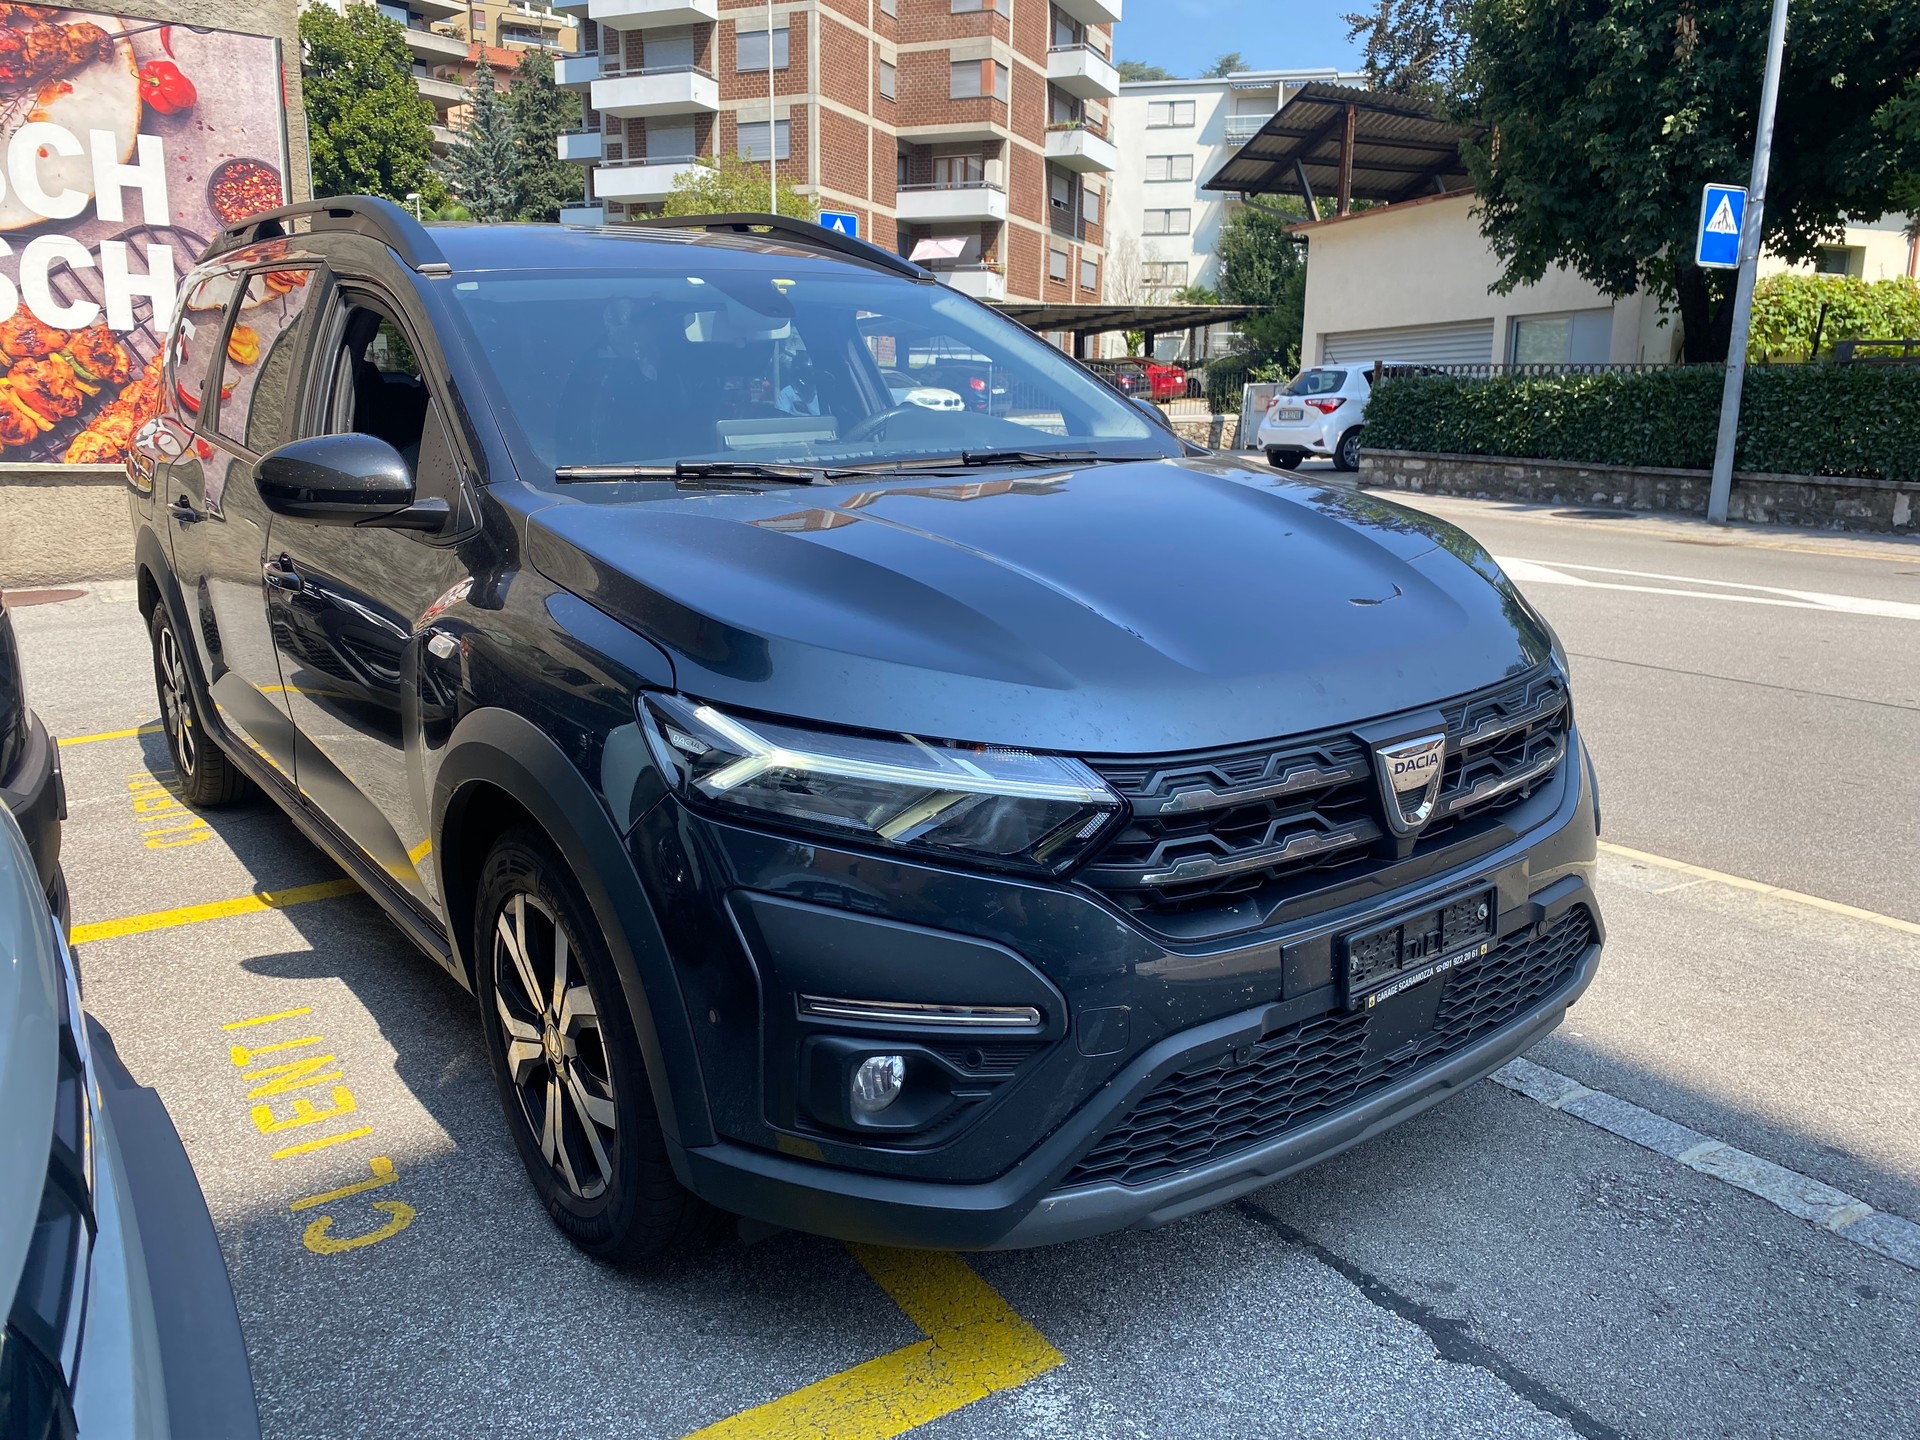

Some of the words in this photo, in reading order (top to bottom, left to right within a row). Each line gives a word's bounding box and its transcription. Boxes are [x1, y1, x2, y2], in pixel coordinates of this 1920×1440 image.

[0, 122, 170, 226] CH
[0, 235, 180, 333] CH
[673, 734, 700, 750] DACIA
[1394, 753, 1438, 775] DACIA
[1377, 985, 1398, 1003] GARAGE
[1398, 967, 1434, 992] SCARAMOZZA
[1442, 960, 1452, 971] 091
[1453, 954, 1464, 966] 922
[1463, 951, 1472, 962] 20
[1472, 949, 1479, 958] 61
[223, 1007, 416, 1256] CLIENTI
